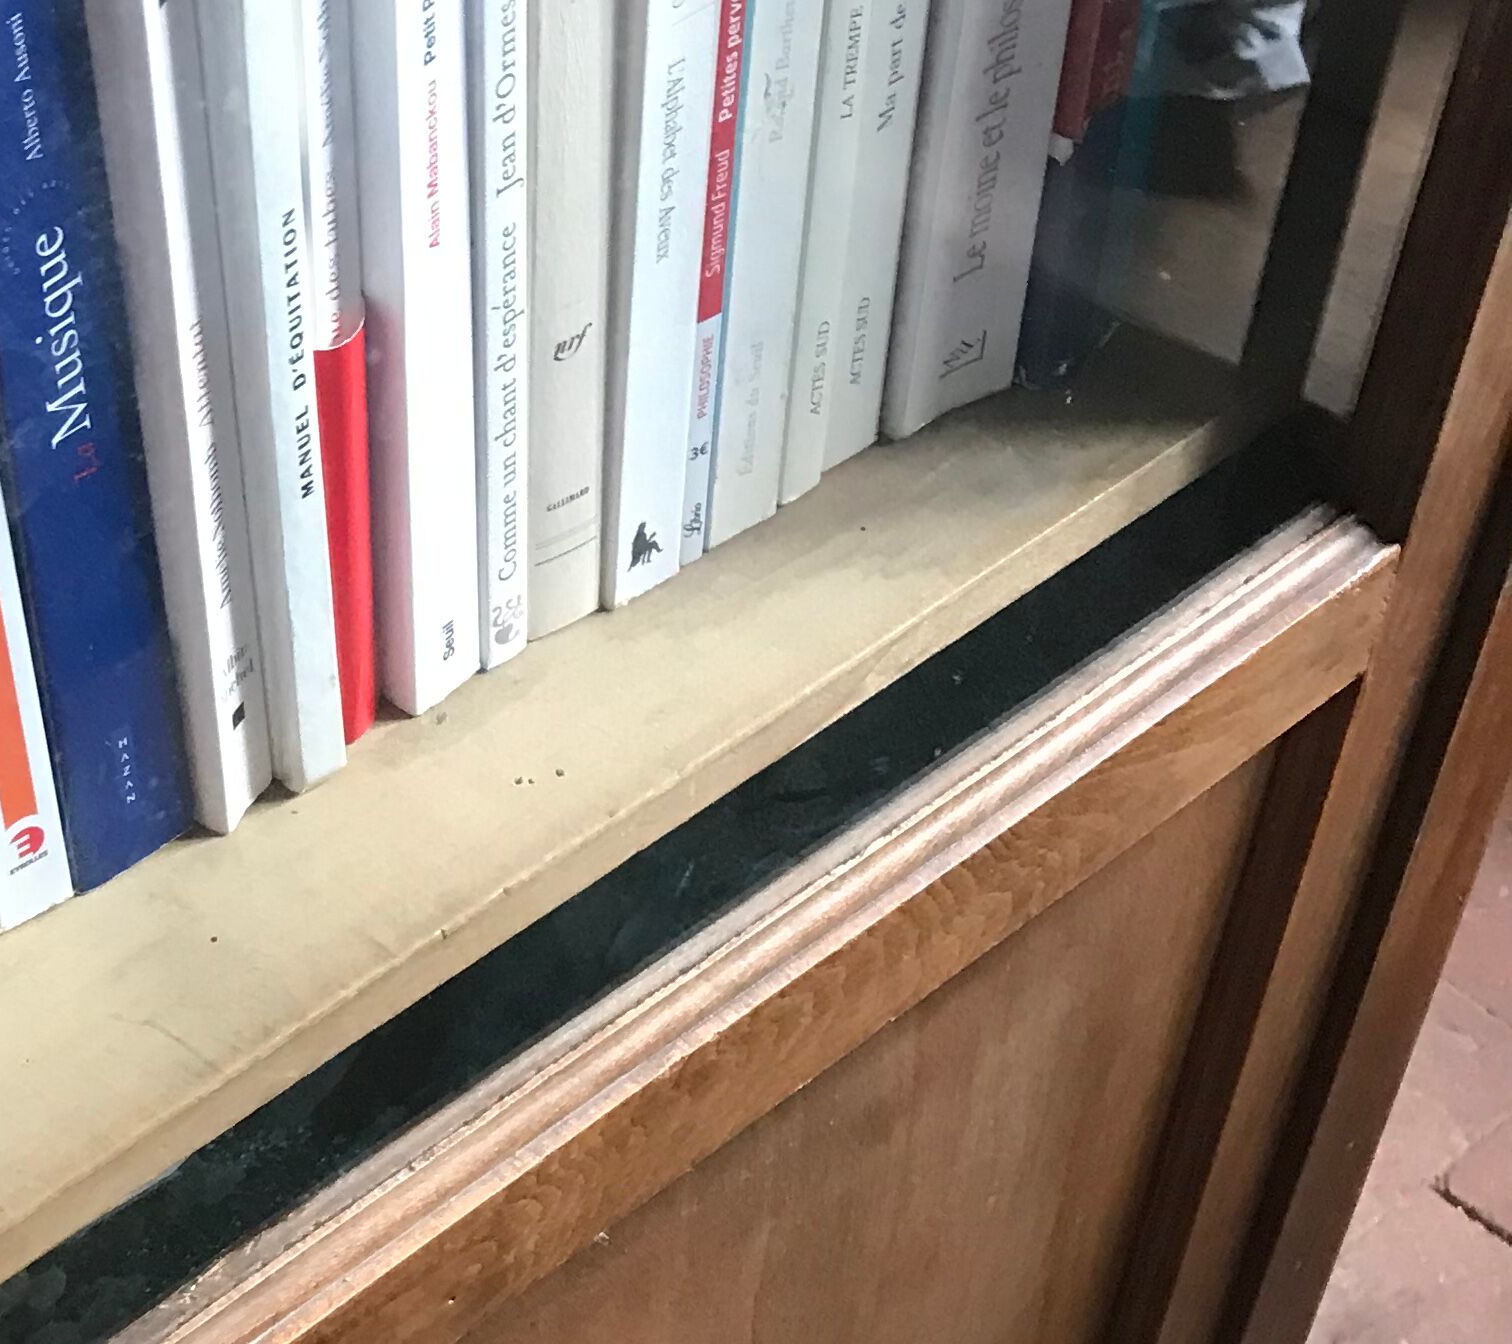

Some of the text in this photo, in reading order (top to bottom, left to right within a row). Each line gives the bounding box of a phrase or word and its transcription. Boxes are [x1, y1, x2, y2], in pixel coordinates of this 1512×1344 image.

[423, 12, 437, 67] Petit
[890, 4, 906, 29] de
[5, 12, 44, 161] Alberto Ausoni
[718, 51, 738, 123] Petites
[840, 5, 864, 119] LA TREMPE
[889, 39, 903, 86] part
[877, 93, 896, 132] Ma
[975, 88, 1010, 124] le
[982, 117, 1003, 149] et
[425, 79, 441, 248] Alain Mabanckou
[496, 130, 524, 198] Jean
[656, 57, 686, 264] L'Alphabet des Aveux
[969, 150, 1001, 240] moine
[705, 149, 729, 277] Sigmund Freud
[953, 243, 986, 283] Le
[35, 226, 91, 450] Musique
[282, 208, 315, 499] MANUEL D'ÉQUITATION
[553, 322, 593, 361] nrf
[697, 334, 714, 419] PHILOSOPHIE
[810, 321, 830, 415] ACTES SUD
[850, 297, 870, 384] ACTES SUD
[491, 220, 524, 583] Comme un chant d'espérance
[442, 618, 455, 662] Seuil
